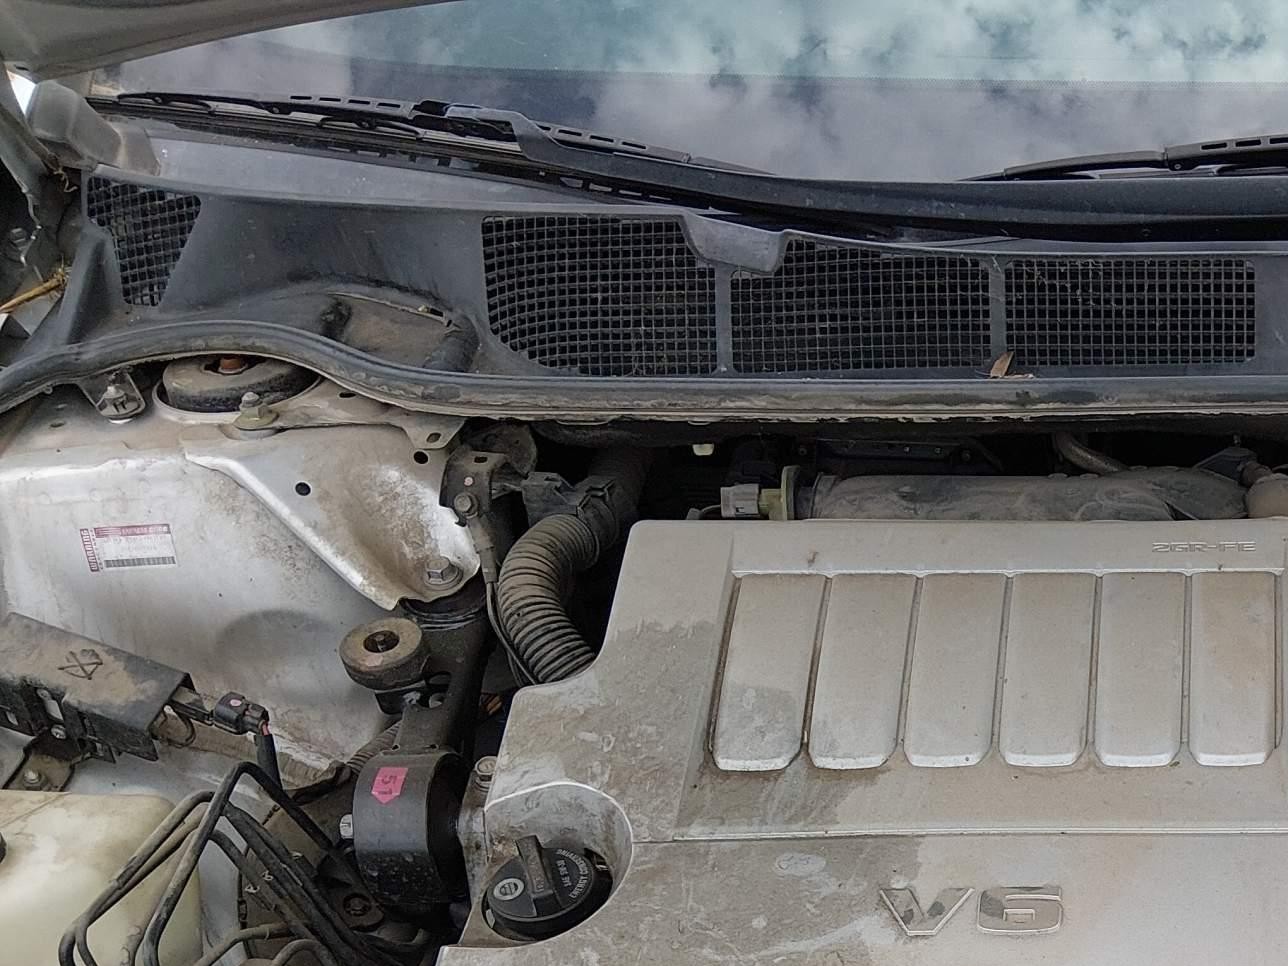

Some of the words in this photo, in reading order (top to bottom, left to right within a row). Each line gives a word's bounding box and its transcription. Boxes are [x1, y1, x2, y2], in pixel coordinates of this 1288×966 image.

[81, 528, 99, 571] WARNING
[1151, 541, 1257, 553] 2GR-FE
[378, 774, 398, 795] 51
[568, 876, 589, 899] ENERGY
[879, 886, 1065, 936] V6
